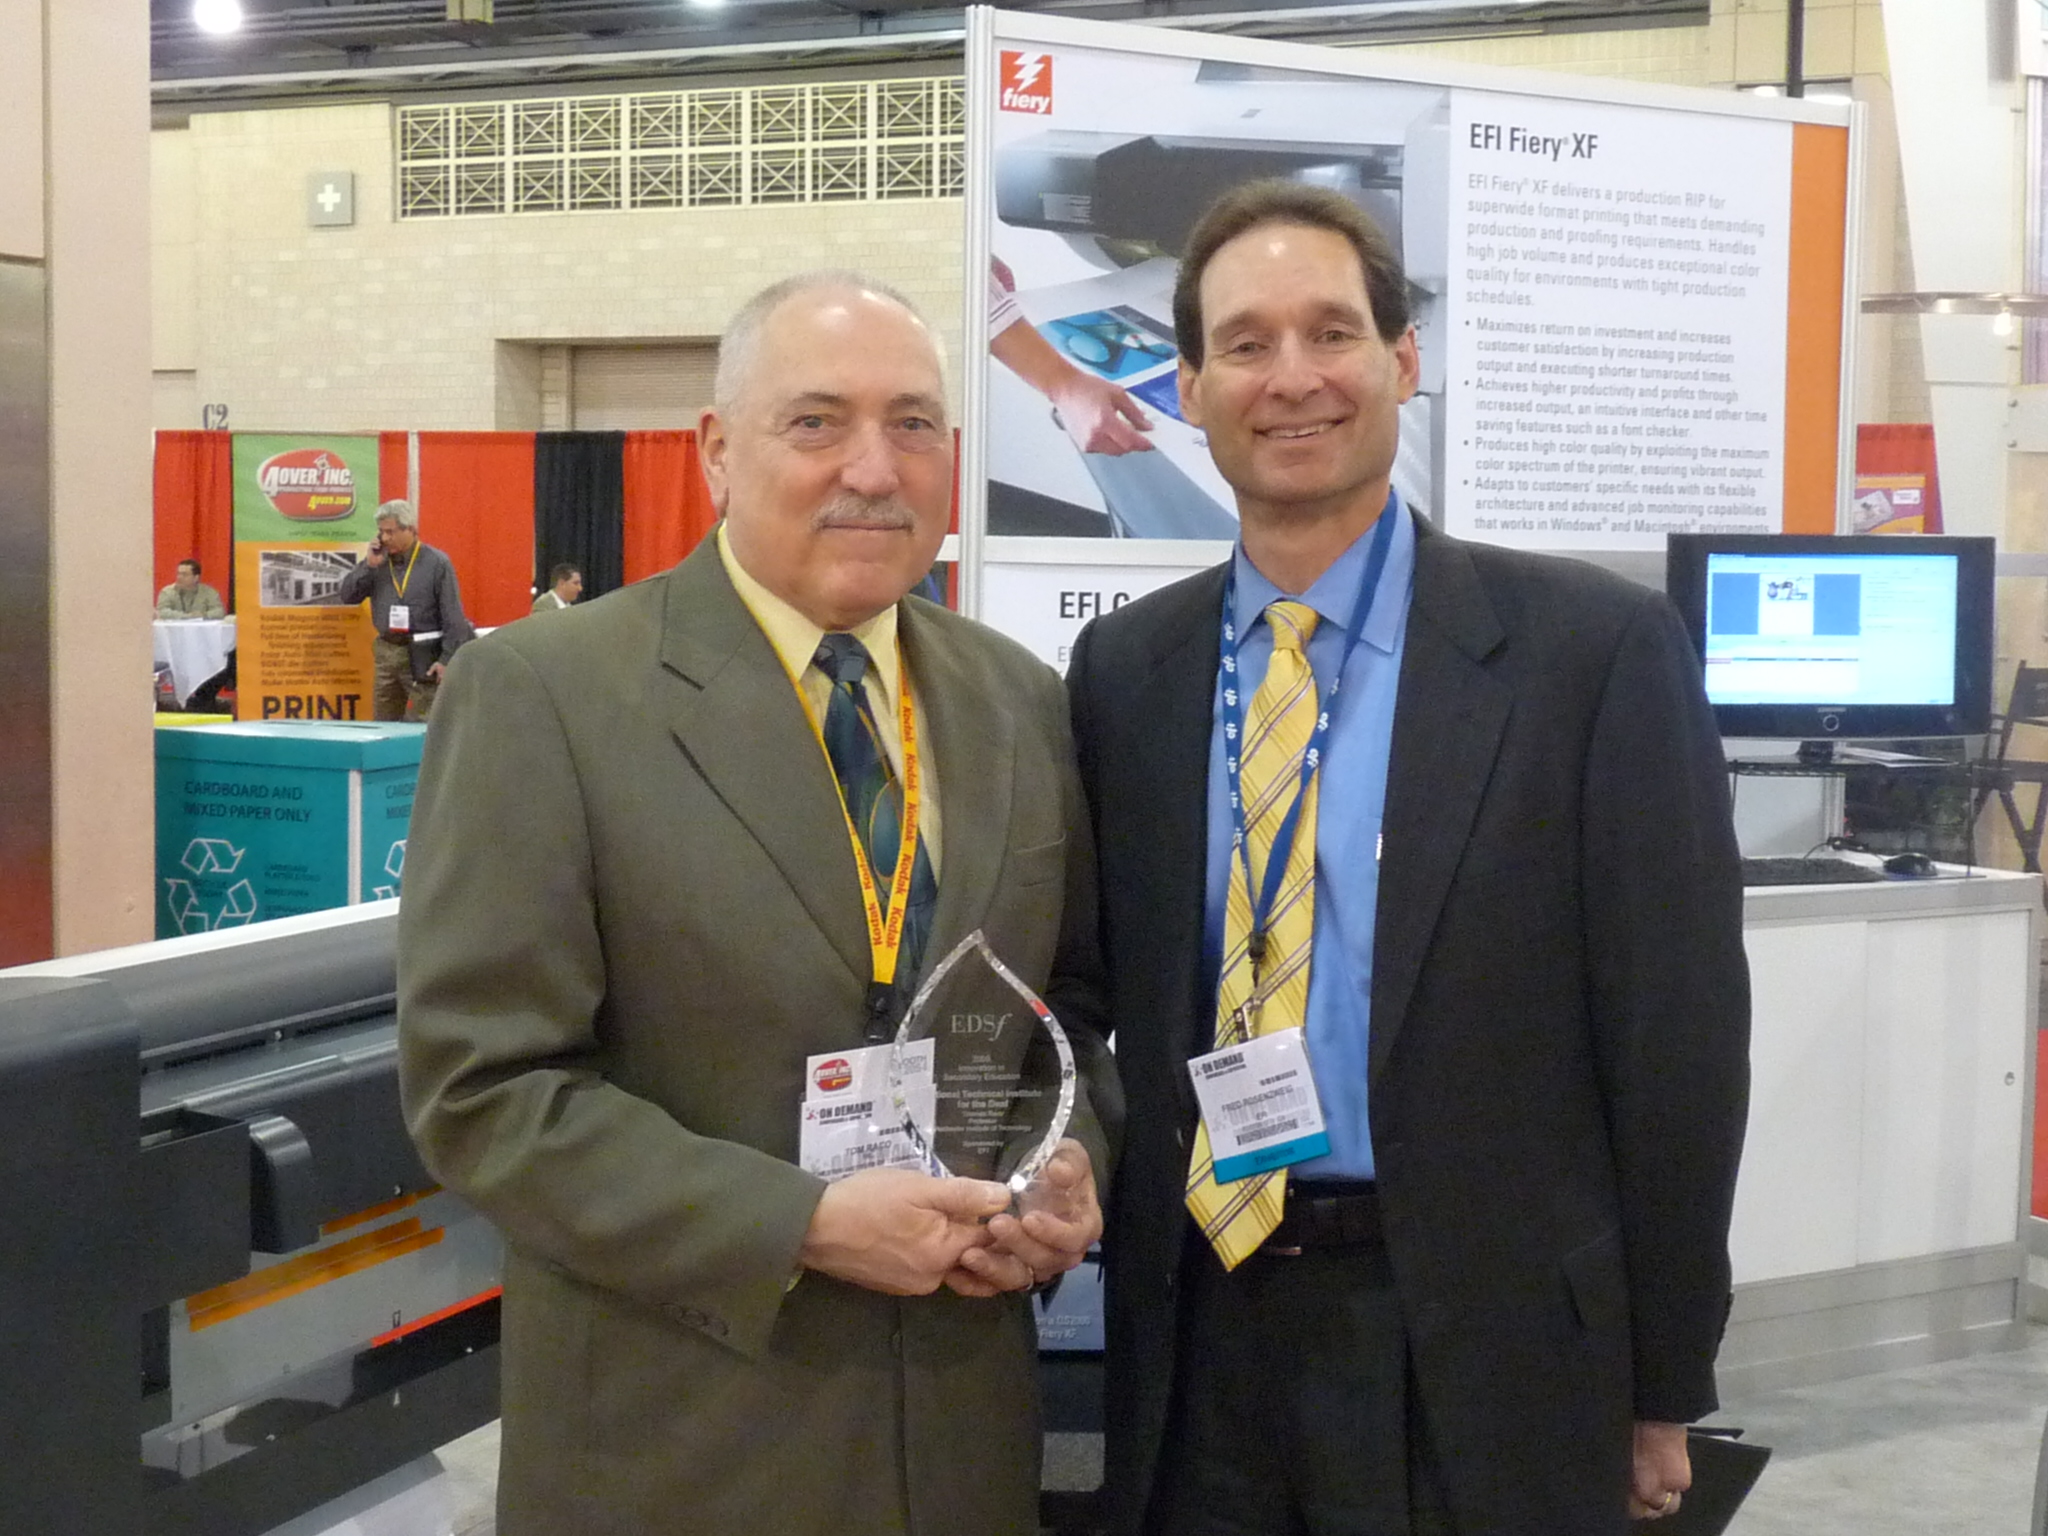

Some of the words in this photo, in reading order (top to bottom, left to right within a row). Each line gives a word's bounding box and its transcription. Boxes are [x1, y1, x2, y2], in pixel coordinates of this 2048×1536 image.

[1003, 87, 1050, 113] fiery
[1470, 123, 1501, 151] EFI
[1572, 132, 1597, 159] XF
[1468, 173, 1488, 191] EFI
[1532, 178, 1548, 196] XF
[1551, 180, 1601, 200] delivers
[1615, 187, 1681, 206] production
[1685, 191, 1705, 208] RIP
[1708, 193, 1724, 210] for
[1467, 199, 1534, 216] superwide
[1538, 201, 1579, 219] format
[1583, 205, 1629, 227] printing
[1633, 208, 1658, 226] that
[1660, 213, 1697, 229] meets
[1700, 213, 1765, 238] demanding
[1467, 222, 1537, 240] production
[1540, 227, 1563, 242] and
[1566, 229, 1618, 250] proofing
[1708, 237, 1756, 256] Handles
[1466, 241, 1494, 262] high
[1497, 245, 1518, 263] job
[1521, 247, 1567, 264] volume
[1569, 250, 1593, 266] and
[1596, 252, 1654, 270] produces
[1657, 257, 1728, 276] exceptional
[1729, 261, 1759, 277] color
[1466, 267, 1509, 286] quality
[1512, 268, 1531, 284] for
[1534, 271, 1619, 289] environments
[1621, 275, 1648, 291] with
[1651, 277, 1679, 296] tight
[1682, 280, 1745, 297] production
[1476, 317, 1537, 334] Maximizes
[1539, 321, 1574, 336] return
[1577, 326, 1591, 337] on
[1593, 324, 1654, 341] investment
[1656, 328, 1677, 342] and
[1679, 328, 1731, 345] increases
[1476, 339, 1529, 354] customer
[1533, 341, 1599, 357] satisfaction
[1601, 344, 1614, 361] by
[1616, 344, 1674, 364] increasing
[1677, 348, 1734, 364] production
[1476, 358, 1513, 375] output
[1516, 360, 1537, 374] and
[1539, 362, 1595, 380] executing
[1597, 363, 1637, 378] shorter
[1640, 365, 1699, 381] turnaround
[1475, 377, 1528, 393] Achieves
[1531, 380, 1567, 397] higher
[1570, 382, 1635, 401] productivity
[1638, 385, 1658, 399] and
[1661, 386, 1695, 402] profits
[1697, 387, 1738, 405] through
[203, 404, 229, 430] C2
[1475, 396, 1533, 412] increased
[1577, 403, 1591, 415] an
[1594, 401, 1638, 417] intuitive
[1640, 403, 1690, 419] interface
[1692, 406, 1712, 420] and
[1714, 406, 1742, 421] other
[1744, 407, 1767, 422] time
[1475, 418, 1513, 435] saving
[1515, 419, 1563, 434] features
[1565, 422, 1592, 435] such
[1595, 424, 1608, 435] as
[1621, 423, 1643, 437] font
[1475, 437, 1529, 452] Produces
[1531, 438, 1556, 455] high
[1558, 440, 1587, 453] color
[1590, 441, 1627, 458] quality
[1629, 442, 1643, 458] by
[1645, 443, 1698, 460] exploiting
[1700, 444, 1718, 457] the
[1719, 445, 1770, 459] maximum
[323, 468, 354, 486] INC.
[1475, 458, 1504, 472] color
[1507, 459, 1561, 475] spectrum
[1563, 460, 1574, 473] of
[1577, 460, 1595, 474] the
[1639, 463, 1687, 480] ensuring
[1690, 464, 1728, 478] vibrant
[1474, 477, 1514, 494] Adapts
[1517, 478, 1529, 492] to
[1595, 481, 1638, 496] specific
[1641, 482, 1674, 495] needs
[1676, 482, 1700, 496] with
[1703, 483, 1716, 496] its
[1718, 483, 1756, 497] flexible
[1475, 497, 1544, 511] architecture
[1547, 499, 1568, 512] and
[1571, 499, 1625, 513] advanced
[1626, 500, 1644, 516] job
[1646, 501, 1704, 518] monitoring
[1706, 502, 1767, 518] capabilities
[1474, 517, 1497, 530] that
[1500, 517, 1534, 530] works
[1536, 517, 1547, 531] in
[1610, 519, 1631, 532] and
[1060, 591, 1101, 618] EFI
[262, 694, 361, 720] PRINT
[902, 705, 914, 743] Kodak
[906, 752, 917, 791] Kodak
[184, 781, 269, 799] CARDBOARD
[272, 785, 303, 800] AND
[184, 803, 227, 818] MIXED
[230, 805, 271, 820] PAPER
[275, 807, 312, 823] ONLY
[905, 801, 917, 843] Kodak
[895, 853, 912, 895] Kodak
[868, 902, 883, 946] Kodak
[886, 906, 903, 949] Kodak
[951, 1013, 1013, 1041] EDSf
[819, 1107, 832, 1119] ON
[834, 1101, 873, 1117] DEMAND
